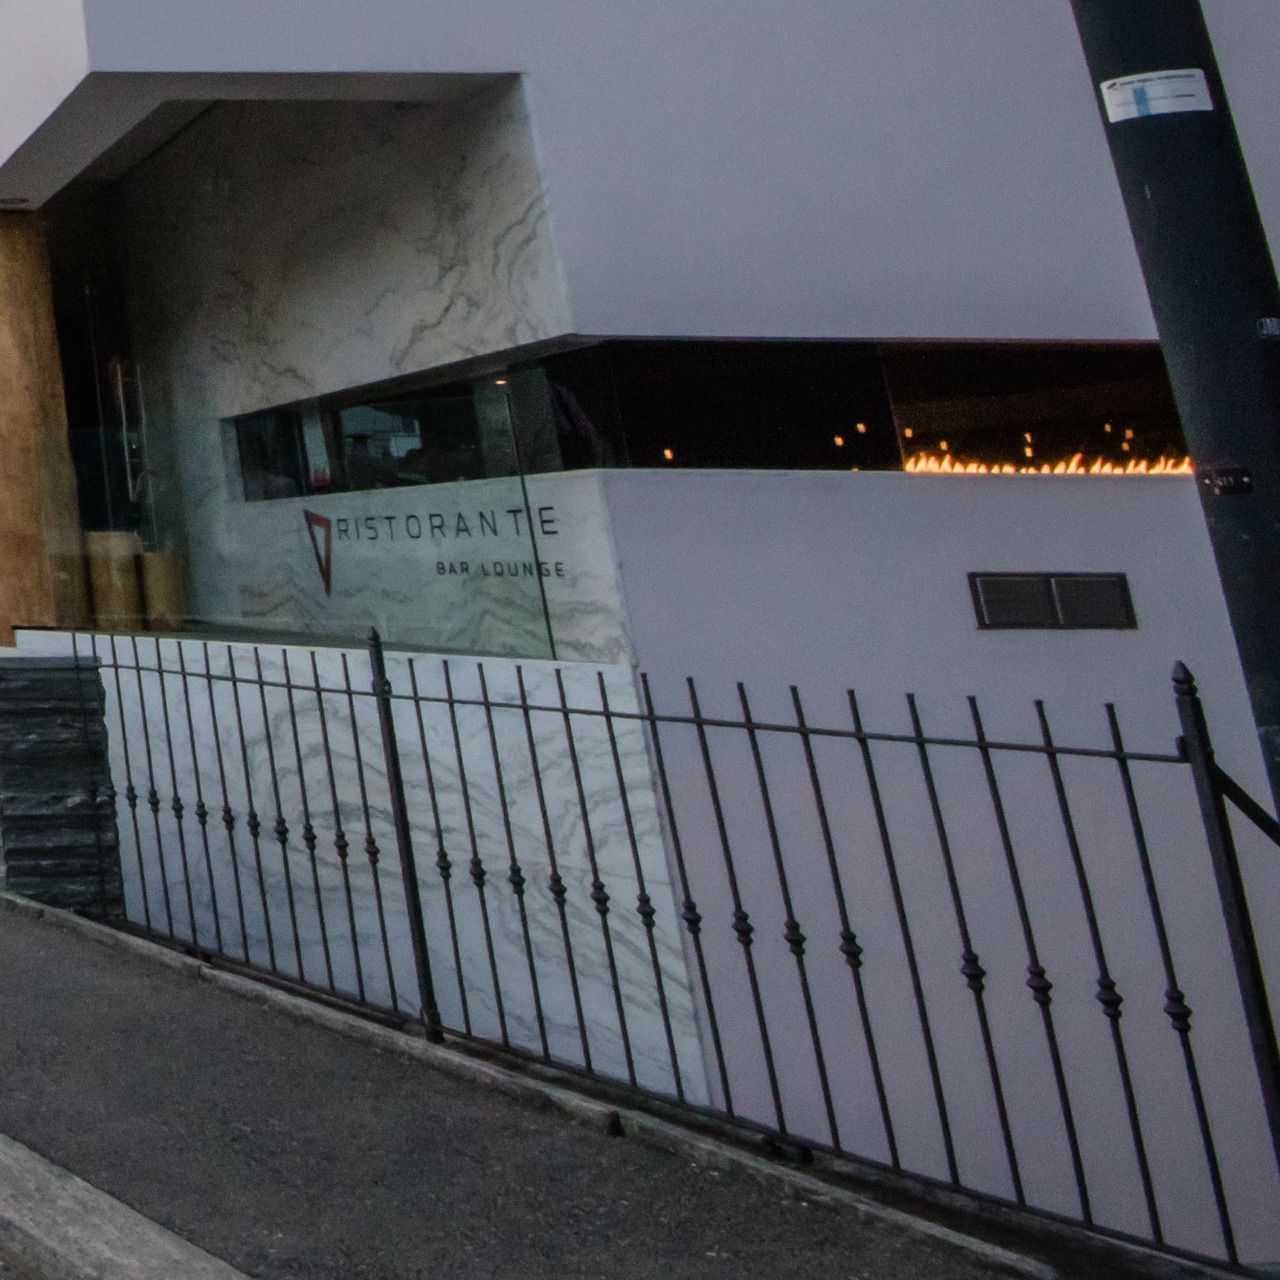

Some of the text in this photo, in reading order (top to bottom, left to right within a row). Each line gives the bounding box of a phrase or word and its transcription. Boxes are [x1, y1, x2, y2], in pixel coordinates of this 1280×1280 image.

[336, 506, 558, 541] RISTORANTE
[436, 561, 566, 578] BAR LOUNGE
